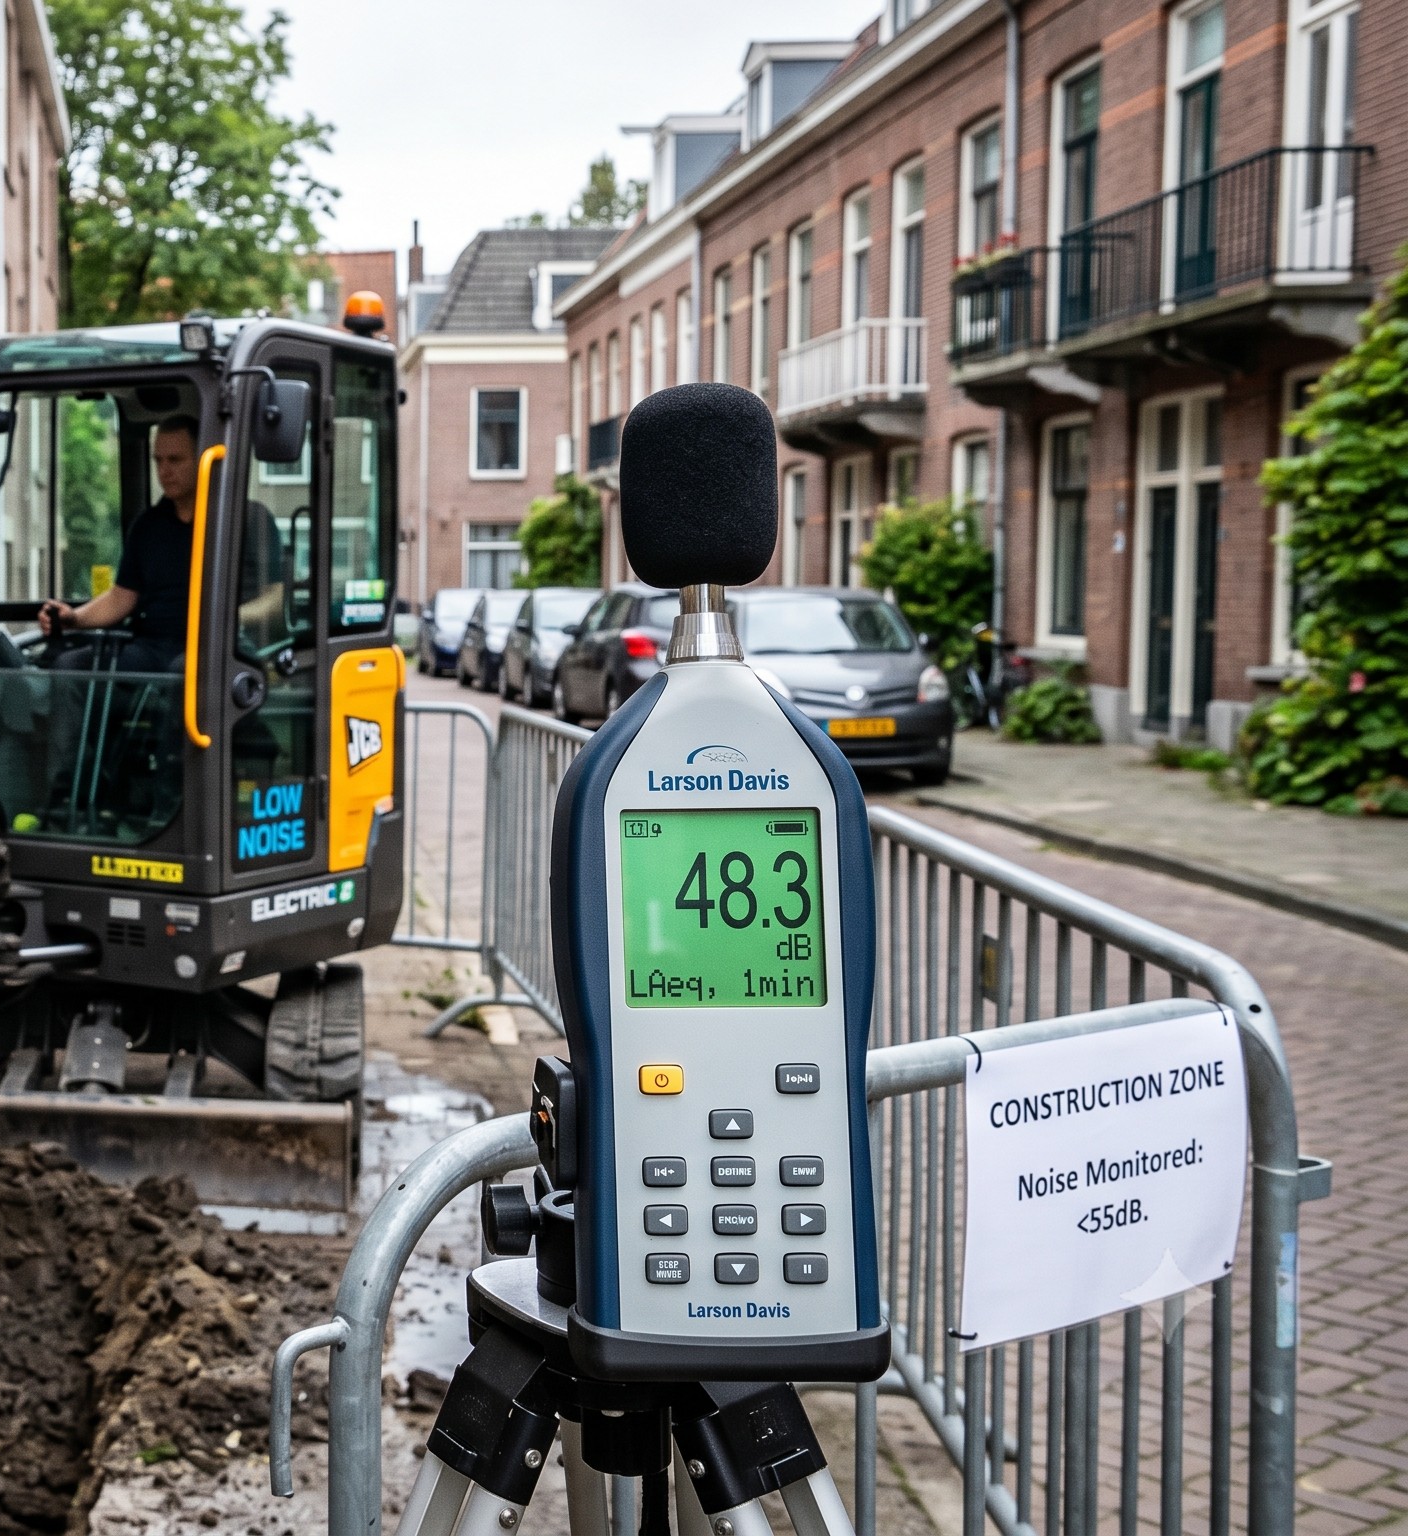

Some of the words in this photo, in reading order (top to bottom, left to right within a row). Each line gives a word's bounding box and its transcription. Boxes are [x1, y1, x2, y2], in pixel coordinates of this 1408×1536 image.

[348, 716, 382, 768] JCB
[648, 770, 722, 792] Larson
[728, 769, 790, 790] Davis
[253, 783, 304, 820] LOW
[238, 819, 306, 860] NOISE
[674, 851, 812, 930] 48.3
[776, 934, 812, 961] dB
[743, 969, 814, 998] 1min
[989, 1072, 1162, 1129] CONSTRUCTION
[1169, 1060, 1225, 1096] ZONE
[1017, 1168, 1078, 1201] Noise
[1085, 1138, 1204, 1187] Monitored:
[1076, 1199, 1149, 1234] <55dB.
[687, 1302, 742, 1319] Larson
[746, 1302, 791, 1318] Davis
